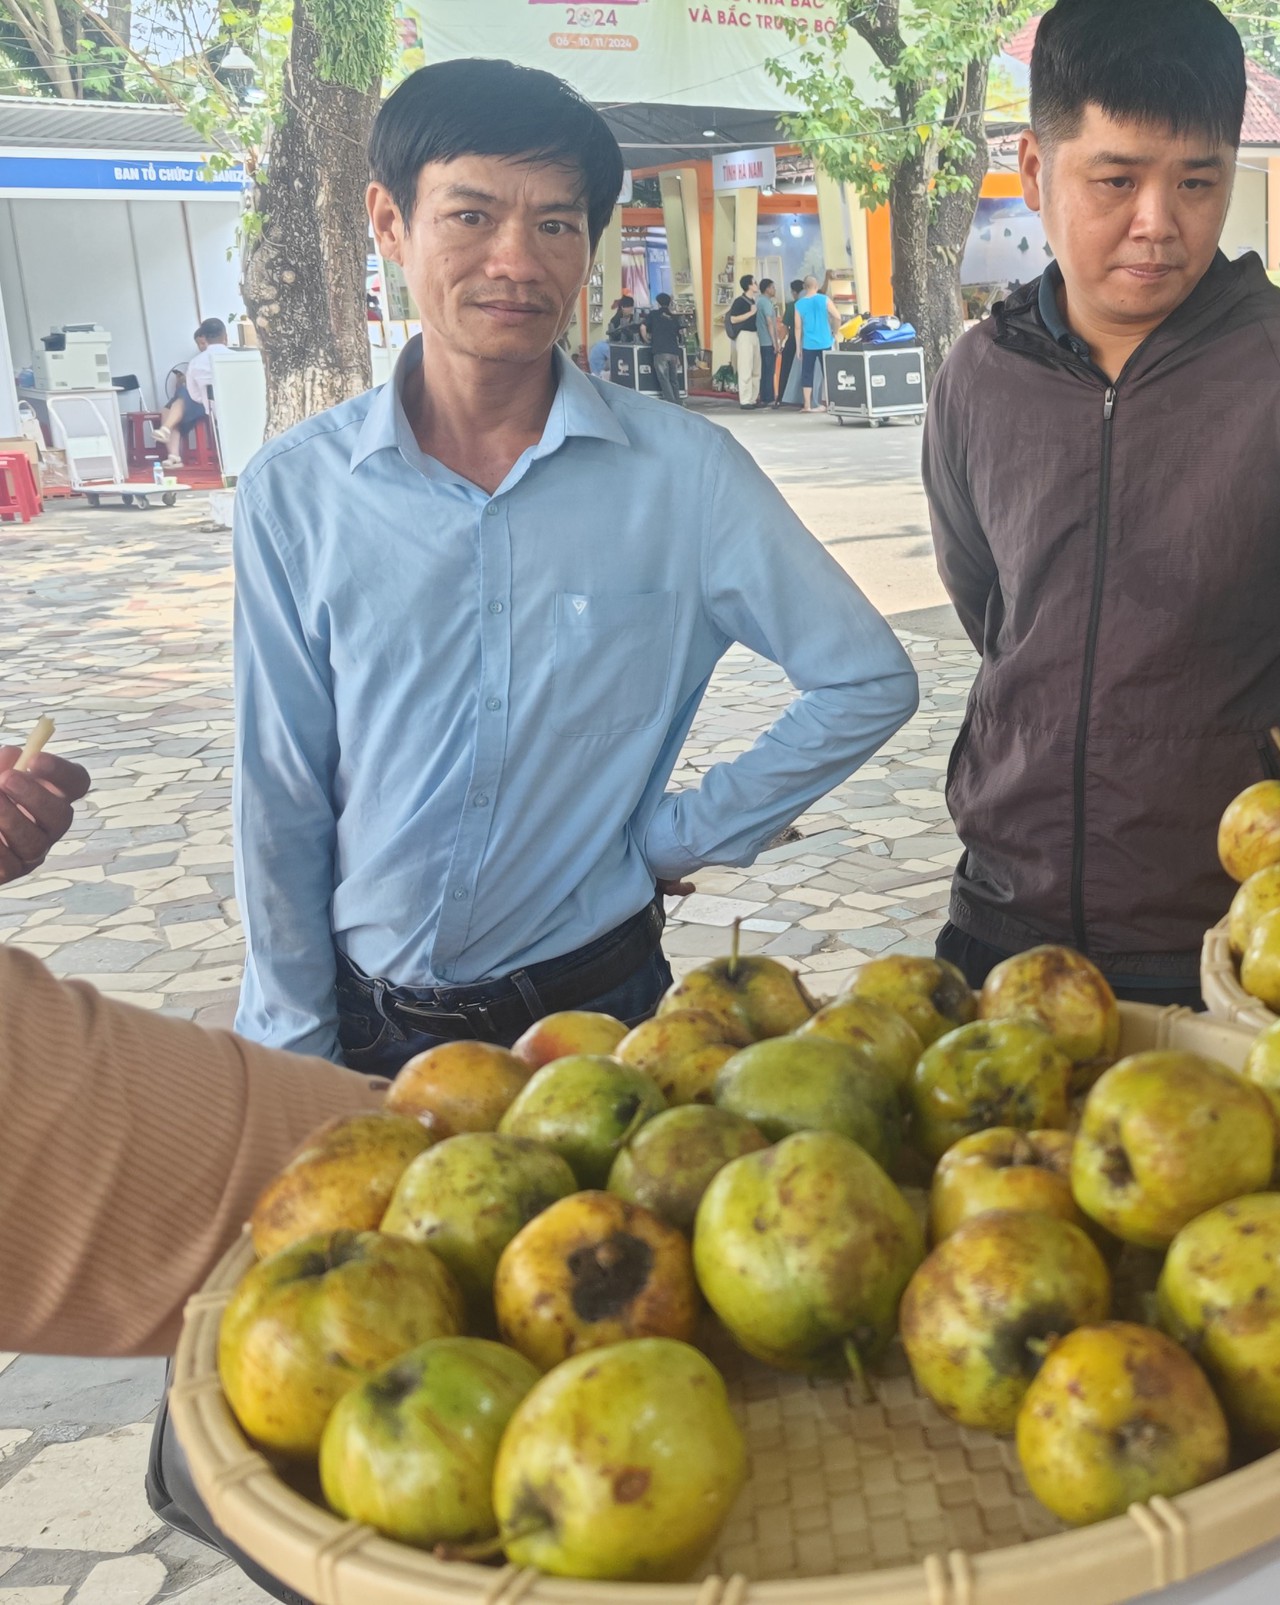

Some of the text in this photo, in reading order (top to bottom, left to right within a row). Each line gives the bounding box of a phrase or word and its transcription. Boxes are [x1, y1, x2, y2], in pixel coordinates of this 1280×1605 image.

[688, 4, 713, 24] VÀ
[717, 4, 751, 27] BẮC
[556, 36, 569, 47] 06
[114, 167, 139, 180] BAN
[748, 160, 764, 179] NAM
